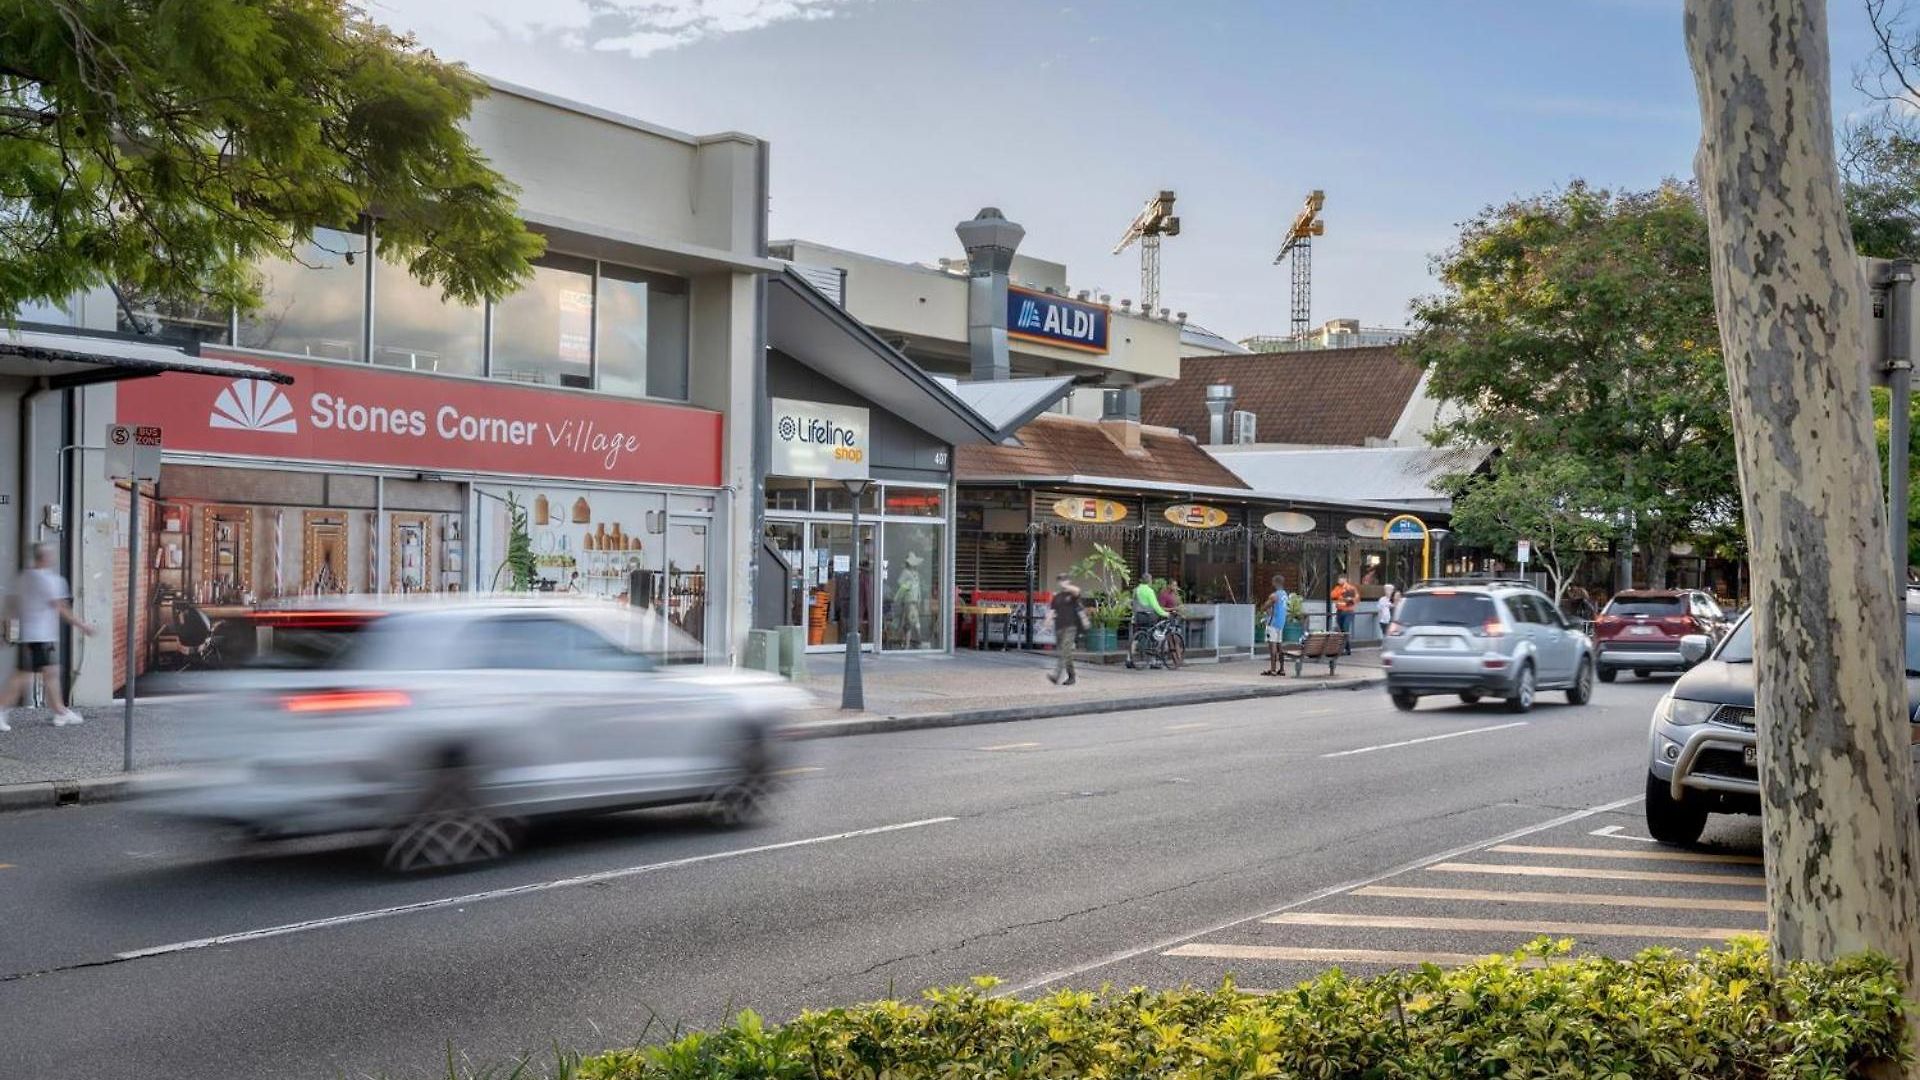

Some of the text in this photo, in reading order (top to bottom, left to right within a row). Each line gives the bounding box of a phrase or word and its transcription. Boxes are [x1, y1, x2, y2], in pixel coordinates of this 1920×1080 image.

[1043, 305, 1094, 340] ALDI
[137, 437, 161, 445] ZONE
[139, 428, 158, 436] BUS
[310, 393, 640, 470] Stones Corner Village
[798, 417, 855, 446] Lifeline
[834, 446, 863, 463] shop
